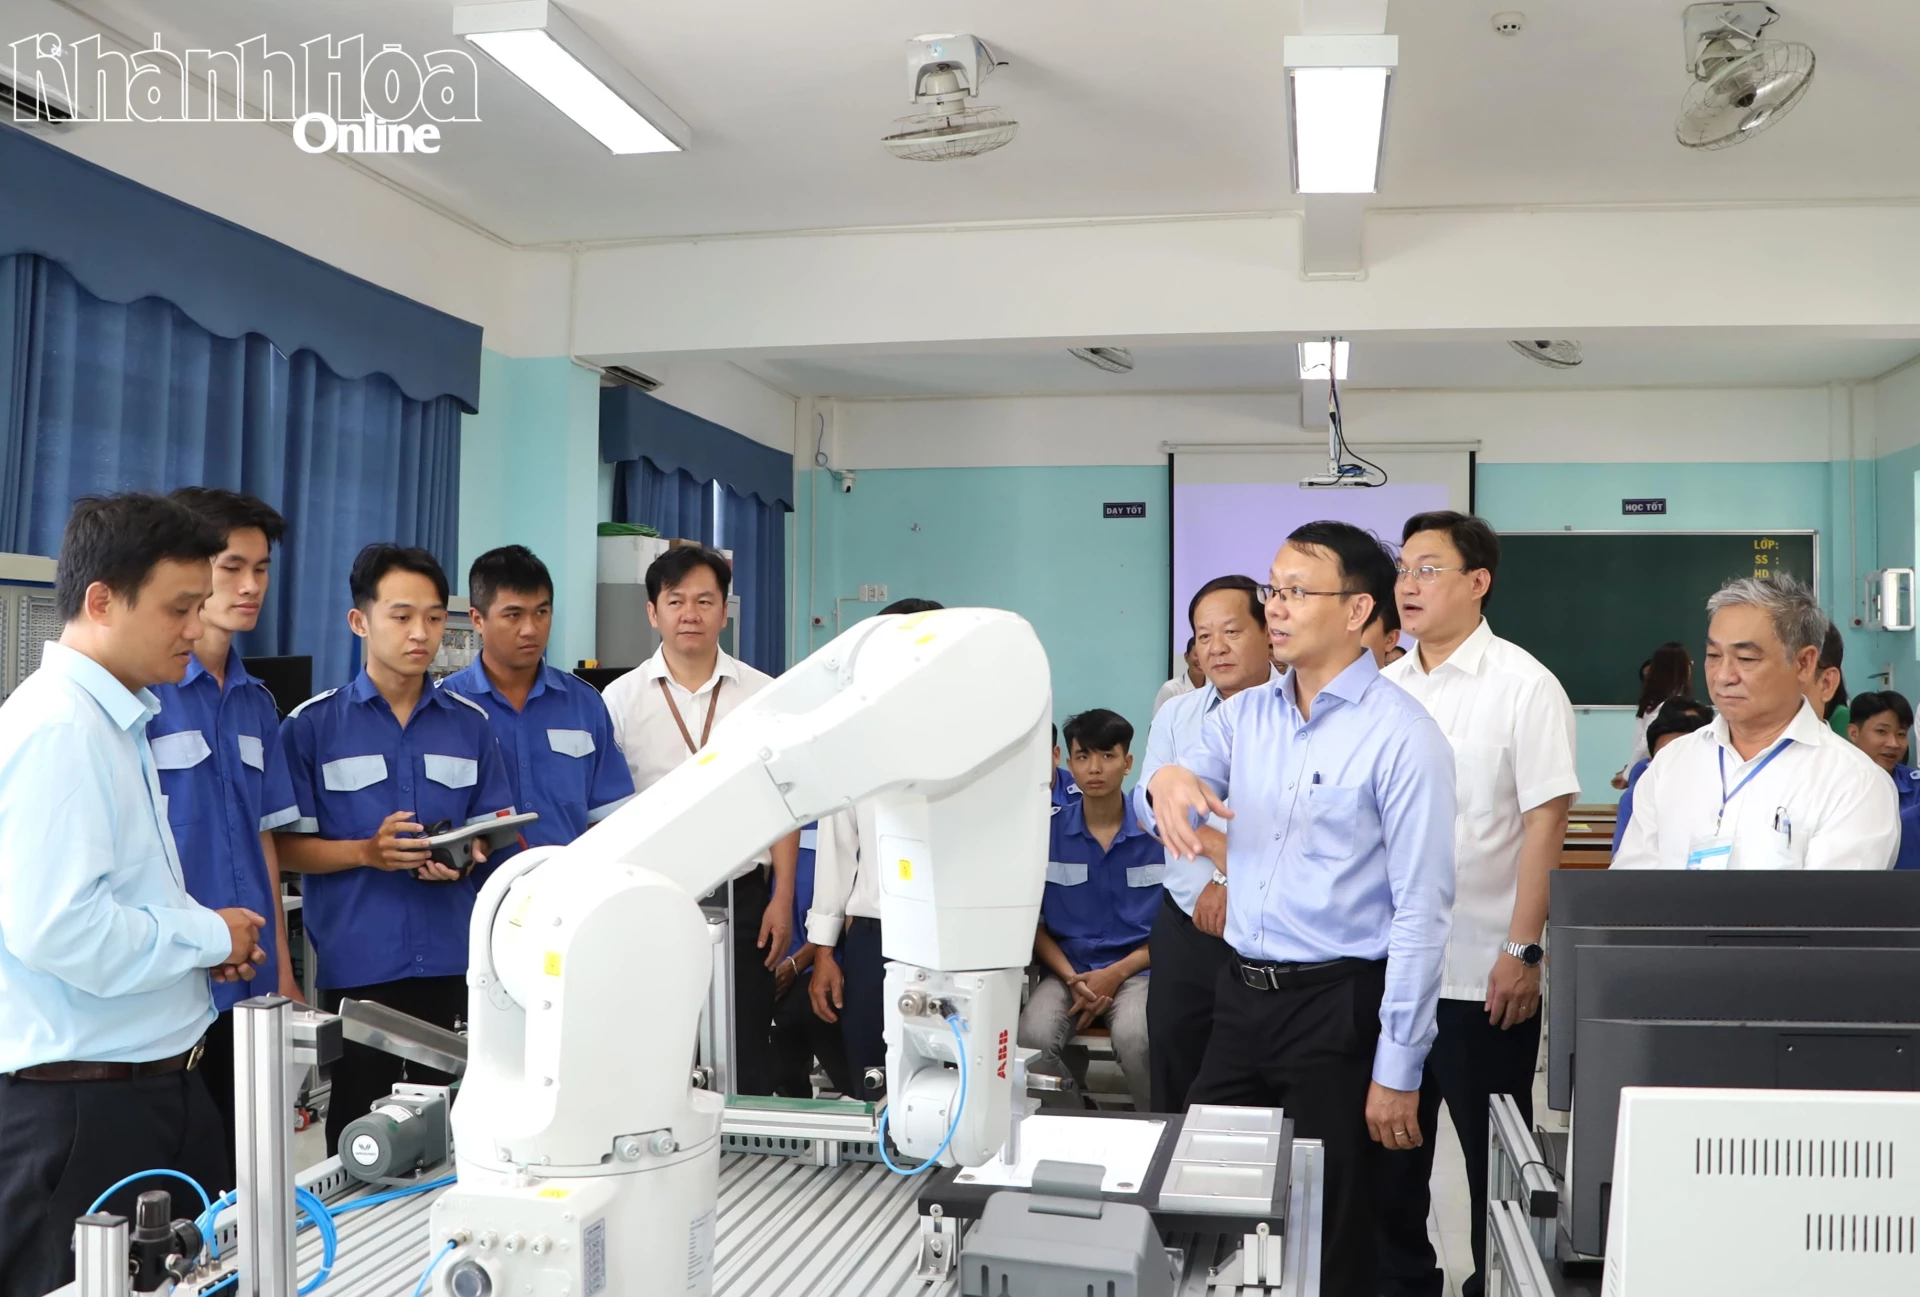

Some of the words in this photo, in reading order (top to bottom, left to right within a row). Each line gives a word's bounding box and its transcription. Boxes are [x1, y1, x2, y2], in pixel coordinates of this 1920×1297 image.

[1126, 504, 1143, 514] TỐT
[1625, 503, 1644, 513] HỌC
[1646, 501, 1663, 511] TỐT
[997, 1029, 1008, 1079] ABB
